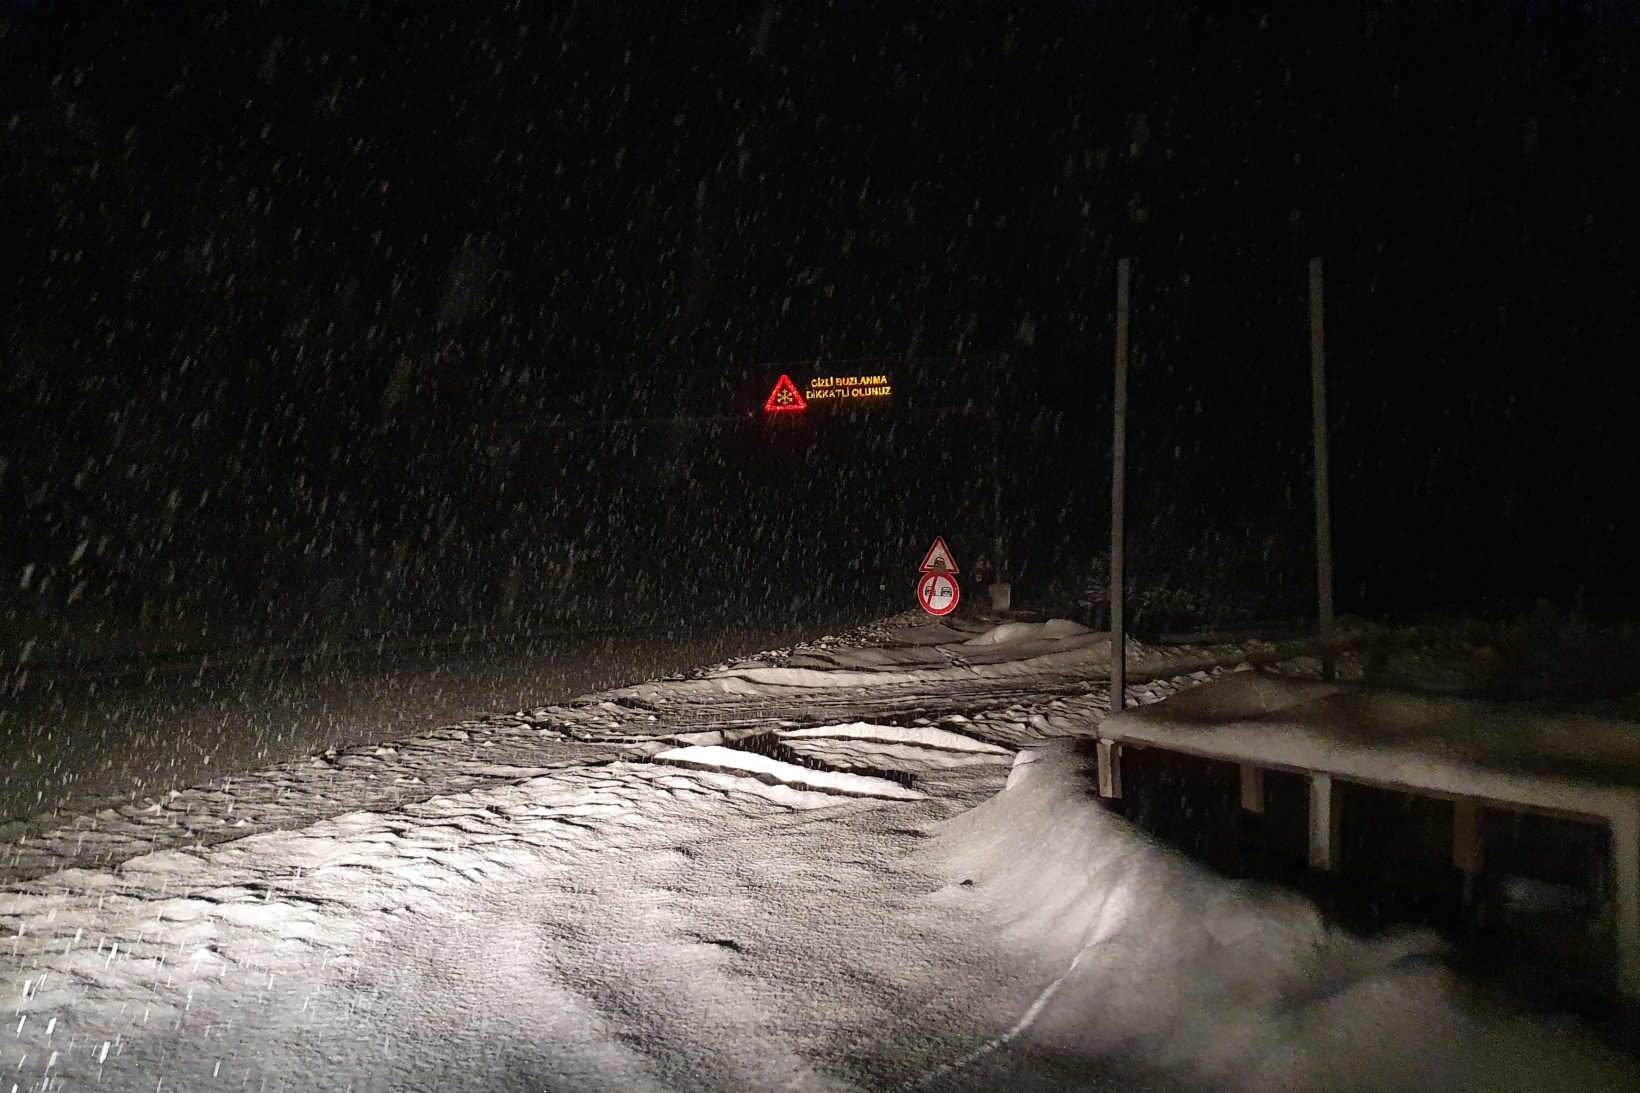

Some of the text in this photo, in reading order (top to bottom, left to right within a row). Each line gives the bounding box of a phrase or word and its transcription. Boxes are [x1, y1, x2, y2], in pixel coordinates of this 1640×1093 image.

[835, 375, 887, 386] BUZLANMA
[806, 386, 892, 399] DİKKATLİ OLUNUZ
